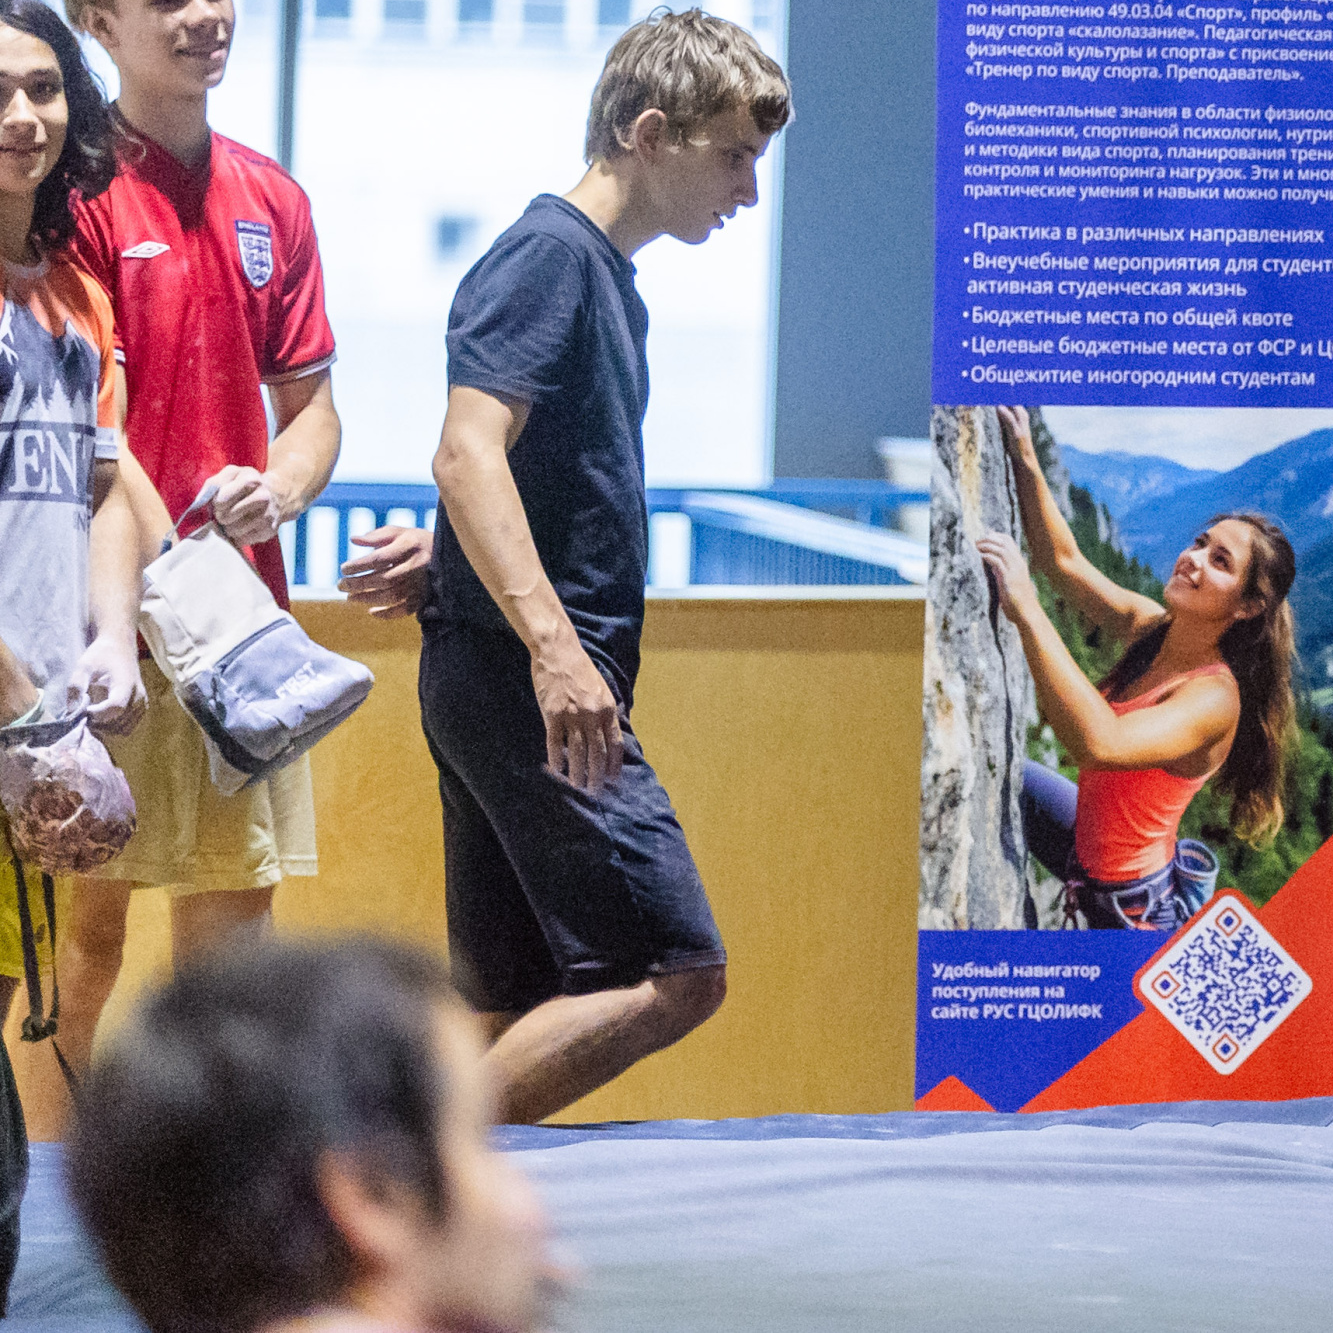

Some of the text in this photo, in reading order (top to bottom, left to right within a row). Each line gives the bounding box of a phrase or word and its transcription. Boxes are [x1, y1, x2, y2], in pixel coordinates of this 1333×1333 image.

[966, 3, 988, 16] по
[990, 3, 1105, 20] направлению
[1107, 3, 1174, 19] 49.03.04
[1176, 4, 1247, 23] «Спорт»,
[1250, 6, 1323, 24] профиль
[965, 23, 1006, 40] виду
[1007, 23, 1065, 41] спорта
[1067, 25, 1200, 39] «скалолазание».
[1203, 24, 1333, 43] Педагогическая
[965, 42, 1064, 60] физической
[1067, 45, 1143, 62] культуры
[1146, 47, 1158, 58] и
[1160, 46, 1226, 62] спорта»
[1228, 47, 1238, 60] с
[965, 62, 1304, 82] «Тренер по виду спорта. Преподаватель».
[964, 101, 1118, 120] Фундаментальные
[1120, 106, 1178, 118] знания
[1181, 106, 1192, 119] в
[1194, 104, 1261, 120] области
[964, 121, 1079, 139] биомеханики,
[1082, 124, 1180, 141] спортивной
[1182, 126, 1282, 141] психологии,
[963, 143, 976, 156] и
[978, 143, 1058, 159] методики
[1061, 144, 1102, 160] вида
[1104, 145, 1163, 161] спорта,
[1166, 146, 1287, 162] планирования
[963, 163, 1041, 180] контроля
[1043, 165, 1055, 177] и
[1058, 165, 1167, 181] мониторинга
[1169, 166, 1247, 183] нагрузок.
[1251, 164, 1280, 180] Эти
[1282, 169, 1294, 180] и
[963, 183, 1077, 199] практические
[1079, 185, 1140, 201] умения
[1143, 186, 1154, 197] и
[1157, 186, 1220, 199] навыки
[1223, 187, 1279, 200] можно
[973, 221, 1324, 246] Практика в различных направлениях
[972, 251, 1090, 273] Внеучебные
[1093, 256, 1221, 274] мероприятия
[1224, 257, 1258, 275] для
[966, 279, 1248, 299] активная студенческая жизнь
[971, 305, 1294, 329] Бюджетные места по общей квоте
[971, 335, 1055, 356] Целевые
[1058, 335, 1168, 357] бюджетные
[1172, 340, 1228, 355] места
[1232, 342, 1254, 356] от
[1257, 338, 1297, 355] ФСР
[1300, 342, 1313, 355] и
[970, 364, 1316, 389] Общежитие иногородним студентам
[932, 962, 1101, 981] Удобный навигатор
[932, 985, 1065, 1003] поступления на
[931, 1003, 1102, 1022] сайте РУС ГЦОЛИФК
